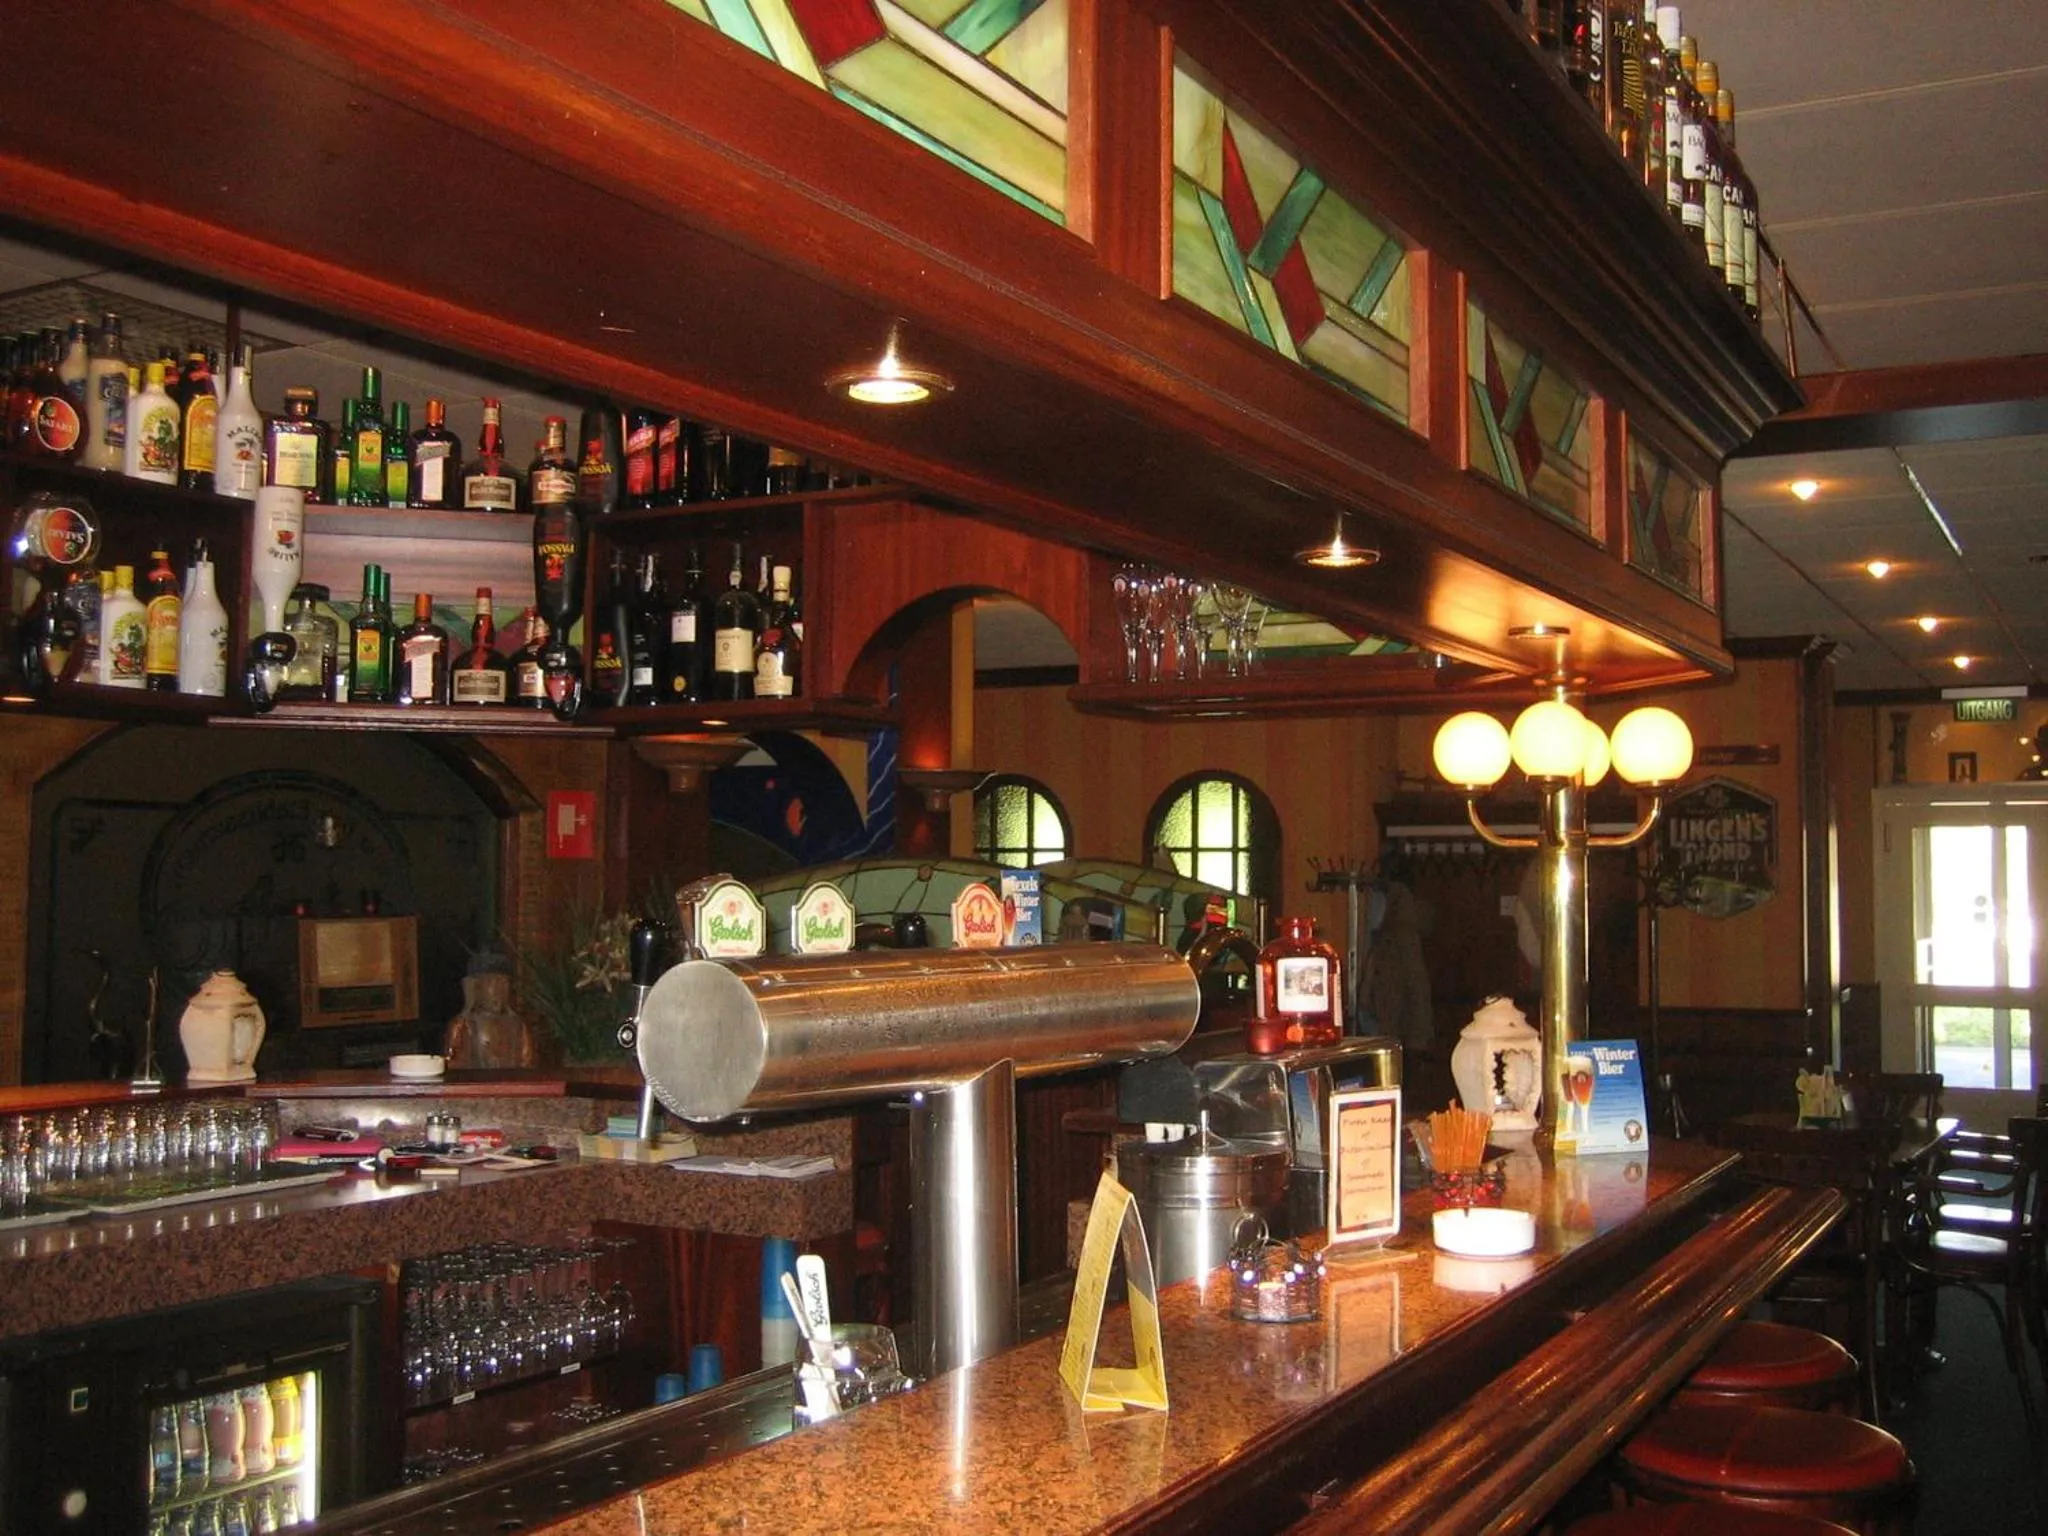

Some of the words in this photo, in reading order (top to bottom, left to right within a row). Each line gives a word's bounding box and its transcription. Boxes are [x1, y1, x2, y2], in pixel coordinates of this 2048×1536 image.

[1956, 699, 2013, 720] UITGANG
[709, 914, 755, 945] Grolsch
[804, 915, 846, 944] Grolsch
[963, 911, 996, 937] Grolsch
[1592, 1047, 1636, 1061] Winter
[1598, 1061, 1625, 1076] Bier
[808, 1272, 829, 1328] Grolsch
